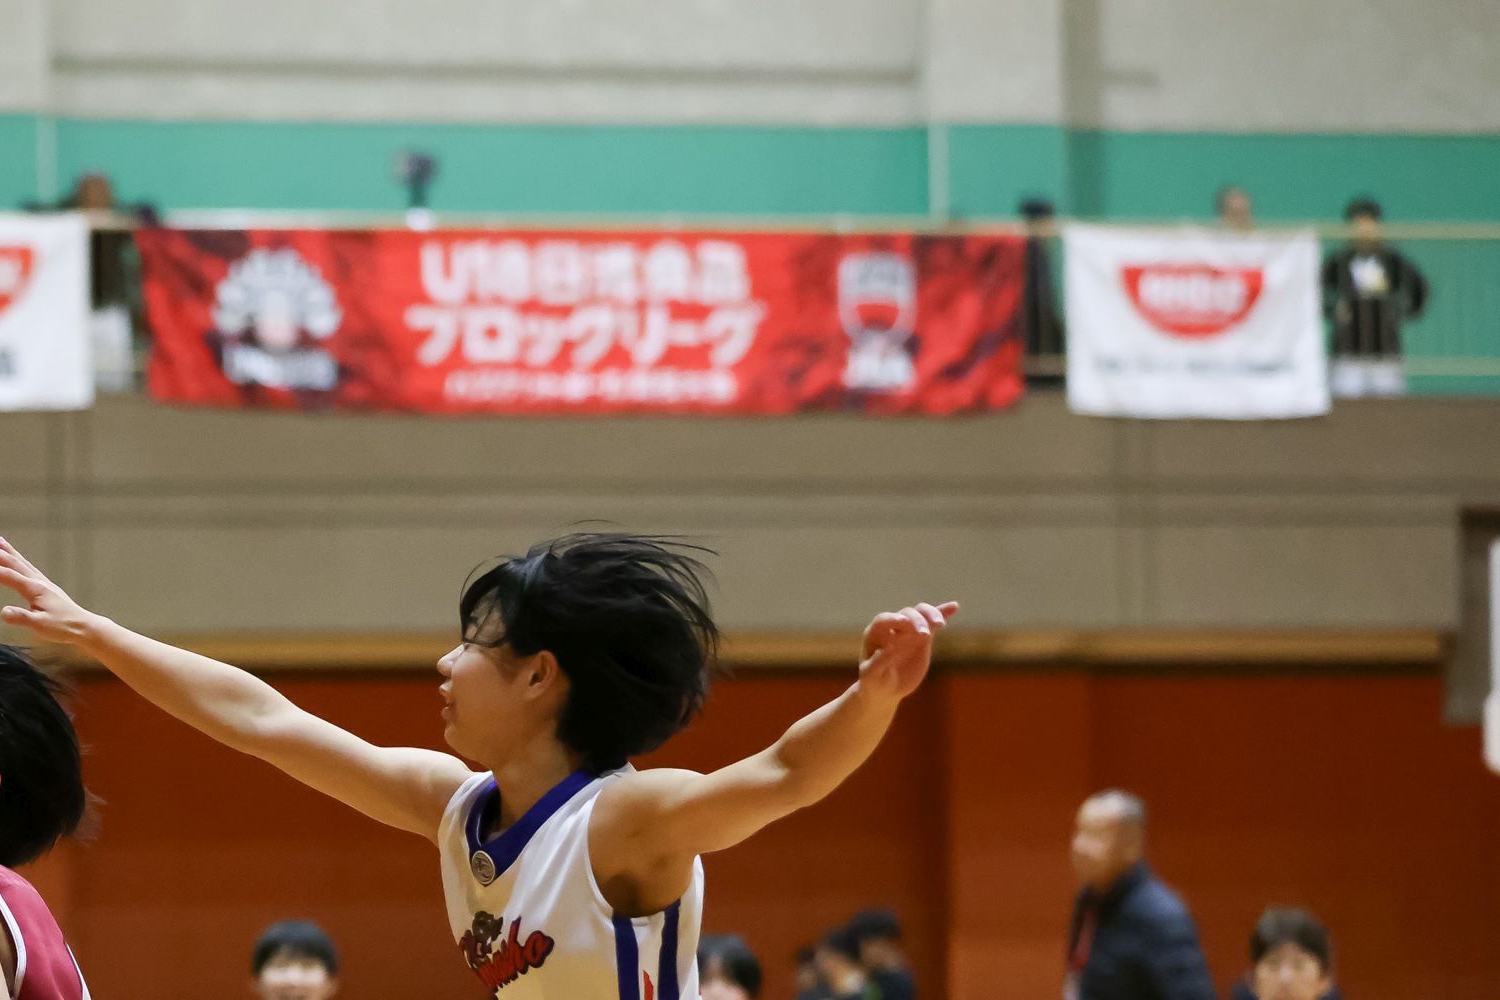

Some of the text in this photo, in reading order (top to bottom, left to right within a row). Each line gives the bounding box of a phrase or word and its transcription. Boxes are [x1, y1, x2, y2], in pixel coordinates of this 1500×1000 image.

[403, 299, 768, 366] ブロックリーグ
